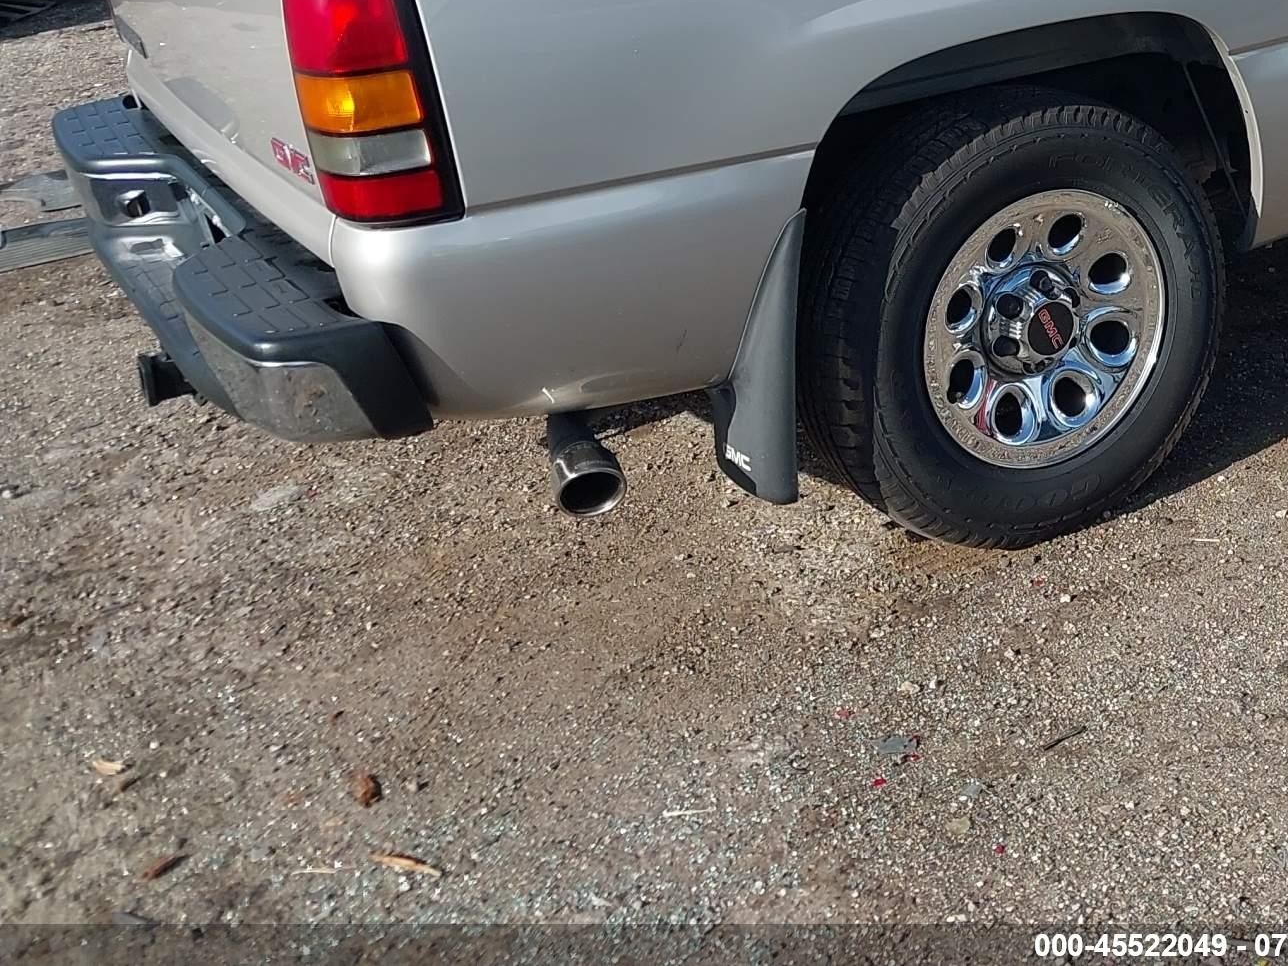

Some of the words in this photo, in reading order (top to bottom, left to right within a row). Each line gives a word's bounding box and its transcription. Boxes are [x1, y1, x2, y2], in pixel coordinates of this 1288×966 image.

[271, 137, 315, 185] GMC
[1038, 308, 1064, 350] GMC
[723, 442, 752, 472] GMC
